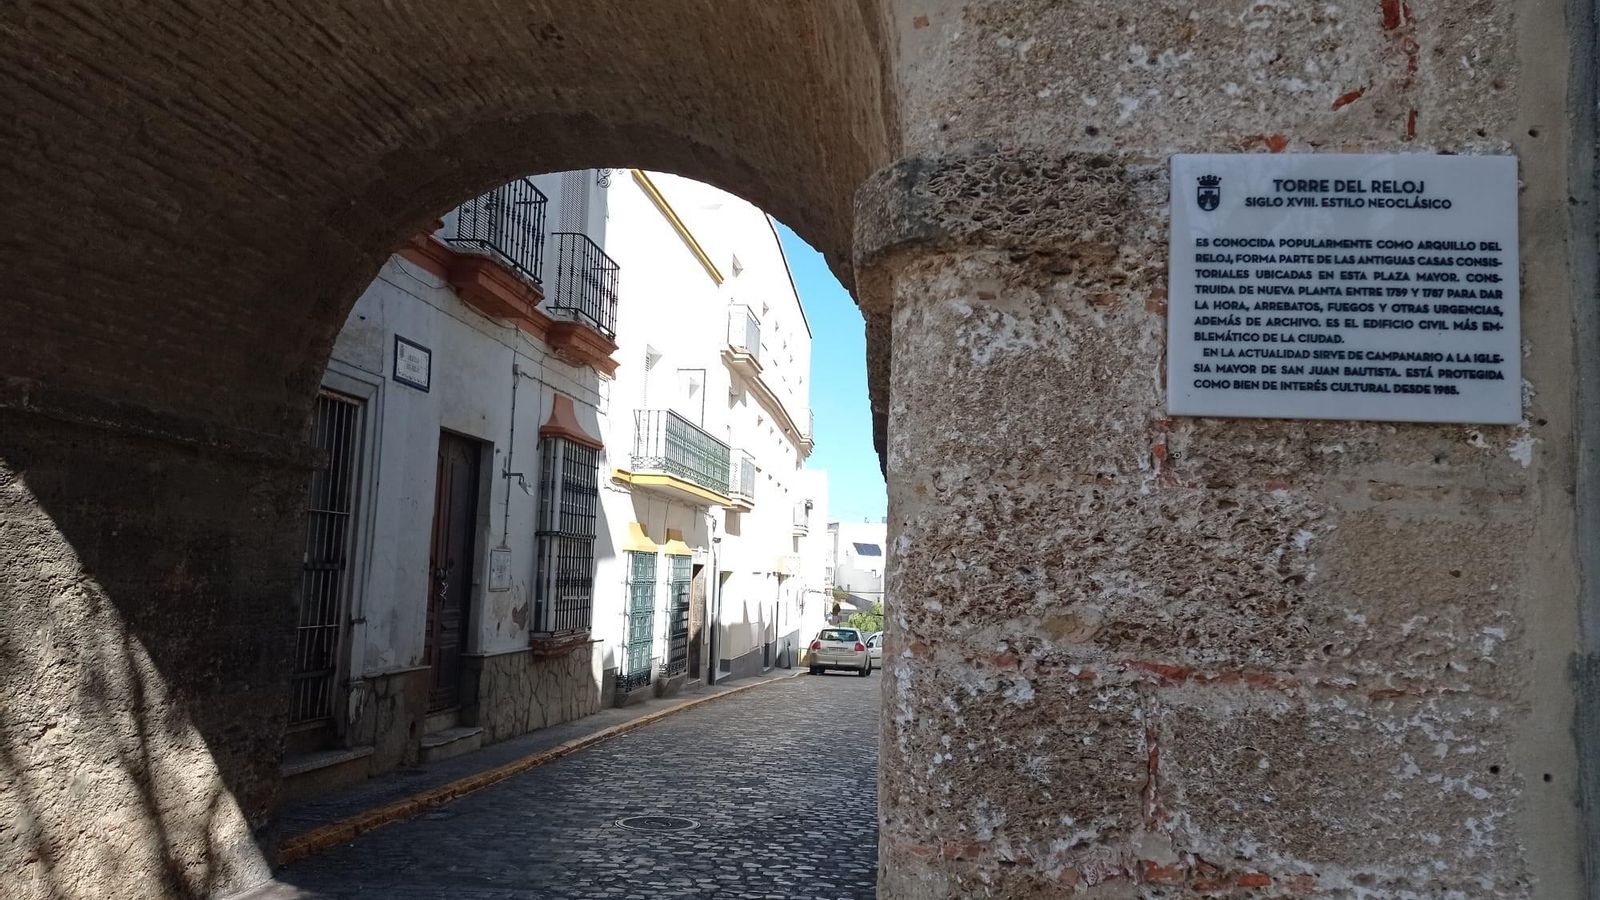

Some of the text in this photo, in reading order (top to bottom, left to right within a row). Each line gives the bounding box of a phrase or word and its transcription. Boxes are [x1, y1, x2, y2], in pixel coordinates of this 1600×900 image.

[1273, 179, 1425, 194] TORRE DEL RELOJ
[1245, 195, 1452, 209] SIGLO XVIII. ESTILO NEOCLÁSICO
[1196, 238, 1502, 251] ES CONOCIDA POPULARMENTE COMO ARQUILLO DEL
[1195, 253, 1503, 267] RELOJ, FORMA PARTE DE LAS ANTIGUAS CASAS CONSIS-
[1195, 269, 1503, 283] TORIALES UBICADAS EN ESTA PLAZA MAYOR. CONS-
[1195, 285, 1236, 295] TRUIDA
[1239, 286, 1254, 295] DE
[1257, 286, 1295, 295] NUEVA
[1298, 286, 1343, 296] PLANTA
[1346, 287, 1383, 297] ENTRE
[1411, 288, 1419, 297] Y
[1447, 289, 1477, 298] PARA
[1480, 289, 1503, 299] DAR
[1195, 300, 1504, 317] LA HORA, ARREBATOS, FUEGOS Y OTRAS URGENCIAS,
[1194, 314, 1504, 331] ADEMÁS DE ARCHIVO. ES EL EDIFICIO CIVIL MÁS EM-
[1194, 330, 1344, 344] BLEMÁTICO DE LA CIUDAD.
[1203, 348, 1504, 364] EN LA ACTUALIDAD SIRVE DE CAMPANARIO A LA IGLE-
[1194, 363, 1504, 380] SIA MAYOR DE SAN JUAN BAUTISTA. ESTÁ PROTEGIDA
[1194, 379, 1230, 389] COMO
[1233, 380, 1259, 390] BIEN
[1262, 381, 1277, 390] DE
[1280, 379, 1328, 391] INTERÉS
[1330, 382, 1391, 393] CULTURAL
[1393, 384, 1431, 394] DESDE
